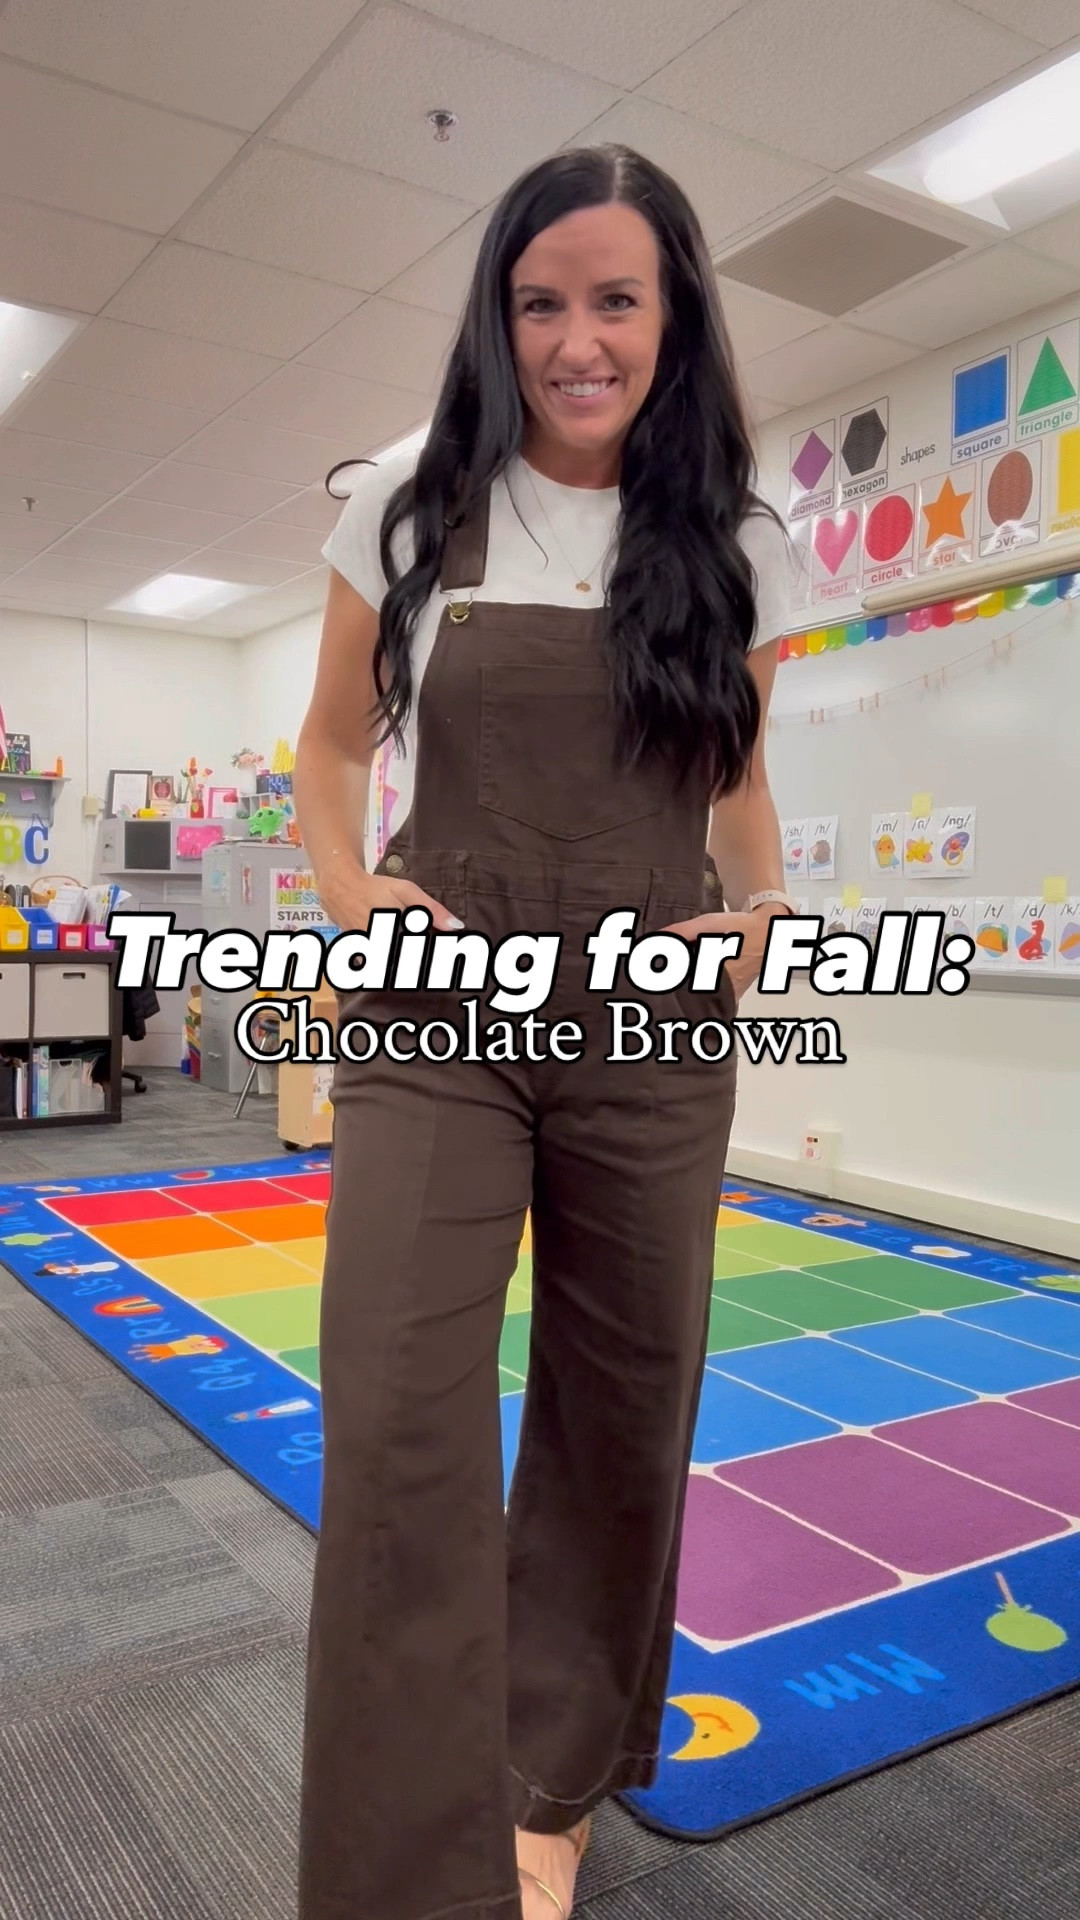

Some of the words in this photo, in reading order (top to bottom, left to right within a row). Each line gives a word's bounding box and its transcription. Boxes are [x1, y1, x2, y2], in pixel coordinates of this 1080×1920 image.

[1020, 411, 1073, 436] triangle
[900, 443, 936, 466] shapes
[956, 435, 1002, 459] square
[791, 495, 832, 517] diamond
[933, 552, 956, 567] star
[870, 566, 903, 584] circle
[820, 581, 849, 597] heart
[277, 910, 324, 921] STARTS
[983, 904, 1004, 919] /t/
[1021, 904, 1046, 919] /d/
